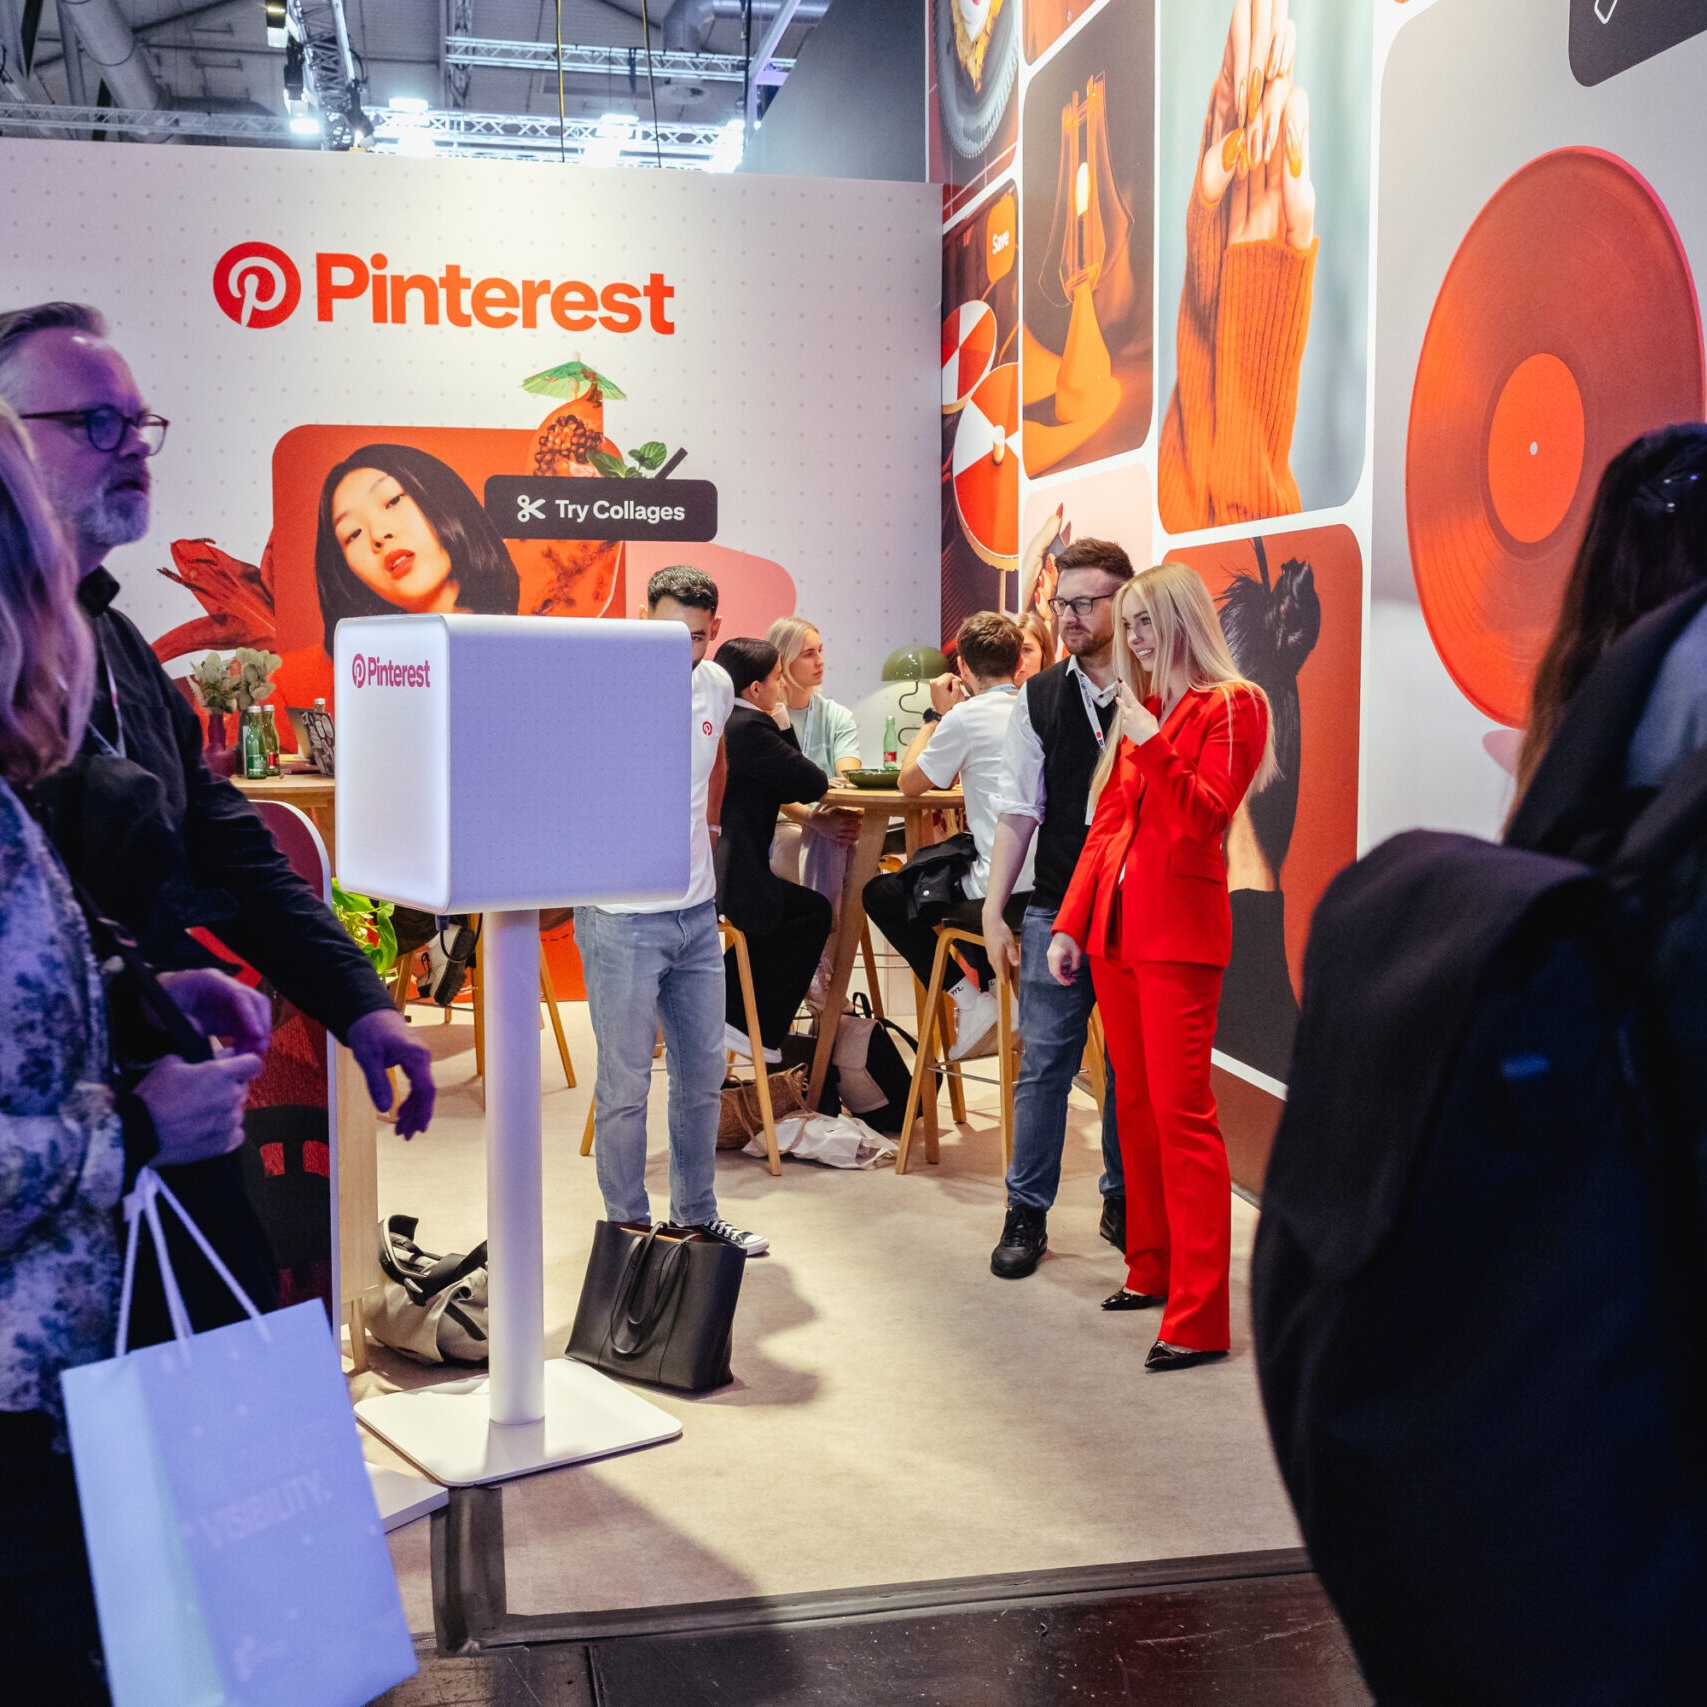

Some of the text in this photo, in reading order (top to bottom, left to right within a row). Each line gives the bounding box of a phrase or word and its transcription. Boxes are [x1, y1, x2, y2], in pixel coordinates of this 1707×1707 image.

[992, 230, 1010, 255] Save
[315, 252, 675, 336] Pinterest
[555, 499, 686, 524] Try Collages
[367, 656, 431, 688] Pinterest
